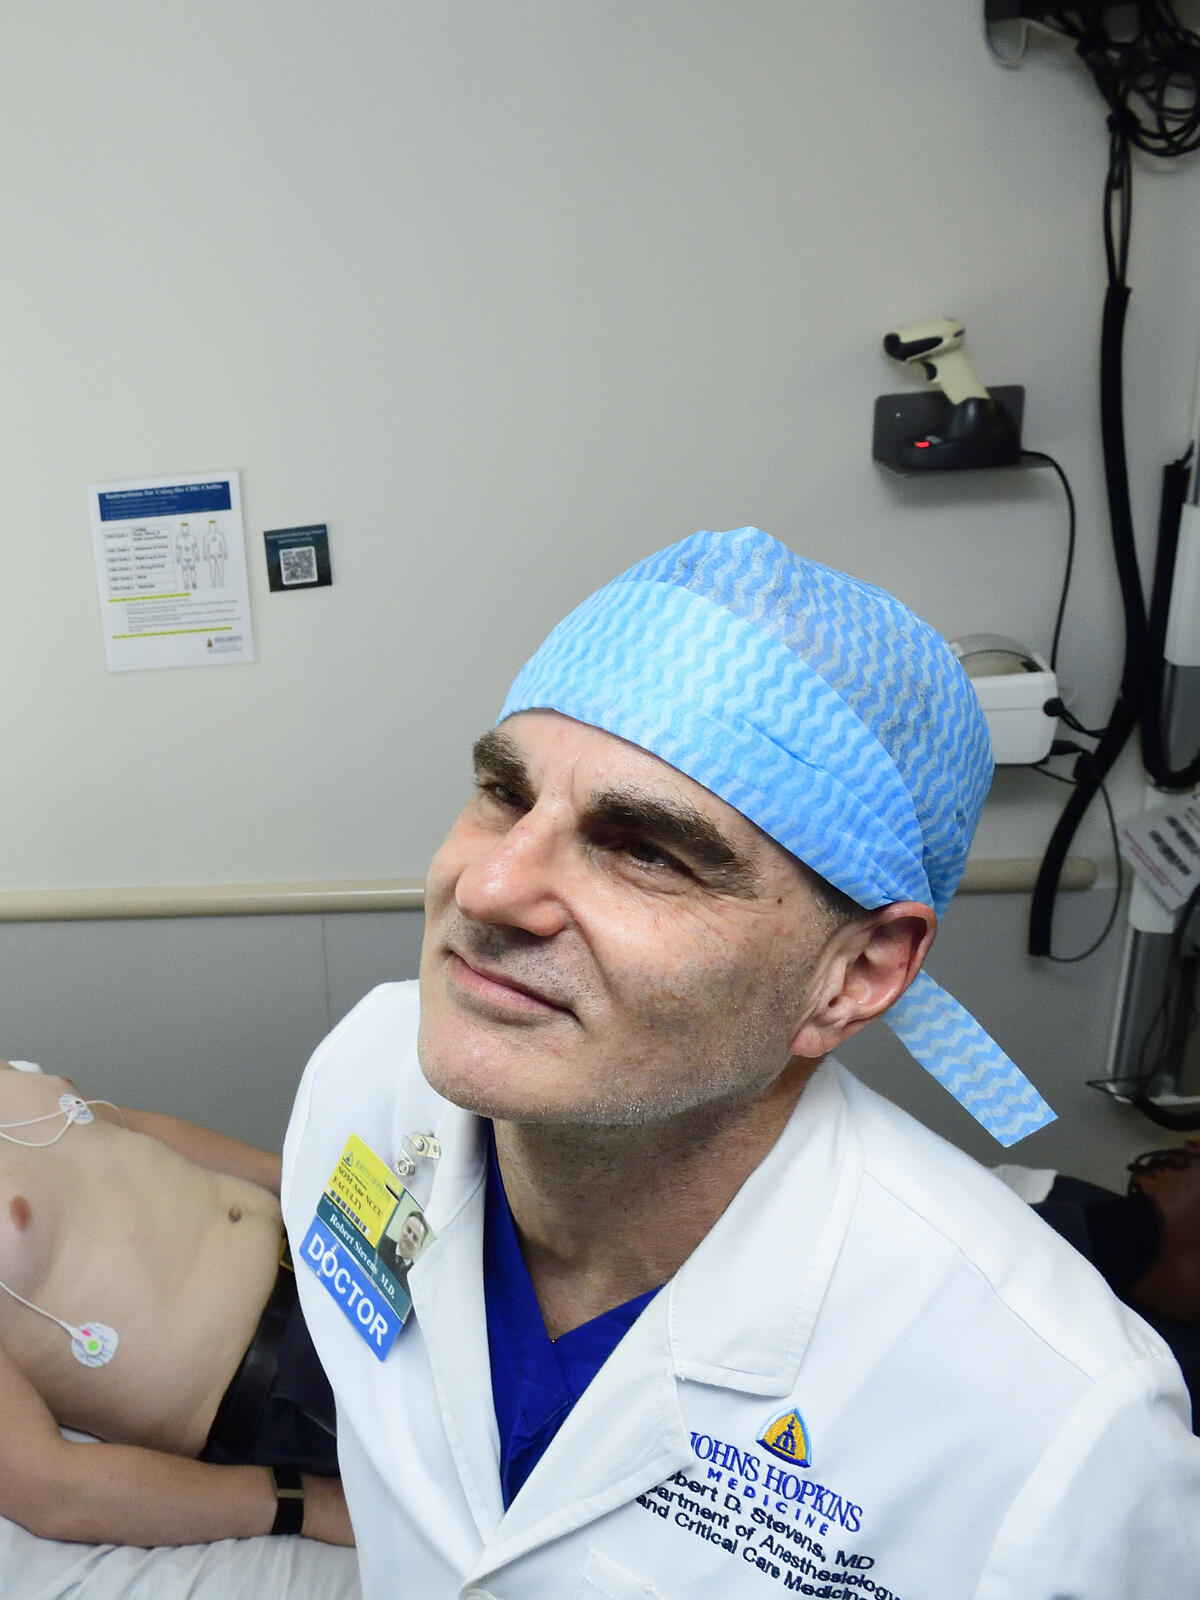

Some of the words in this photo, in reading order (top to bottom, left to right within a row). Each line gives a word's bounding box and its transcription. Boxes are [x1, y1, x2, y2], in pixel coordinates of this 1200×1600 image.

[332, 1176, 362, 1210] FACULTY
[330, 1213, 355, 1245] Robert
[307, 1232, 389, 1347] DOCTOR
[646, 1485, 730, 1530] artment
[735, 1524, 757, 1541] of
[666, 1470, 718, 1503] bert
[750, 1507, 826, 1563] Stevens,
[834, 1549, 875, 1570] MD
[707, 1467, 829, 1536] MEDICINE
[762, 1464, 863, 1533] HOPKINS
[635, 1494, 670, 1520] and
[674, 1512, 739, 1555] Critical
[742, 1546, 781, 1579] Care
[783, 1570, 868, 1600] Medicin
